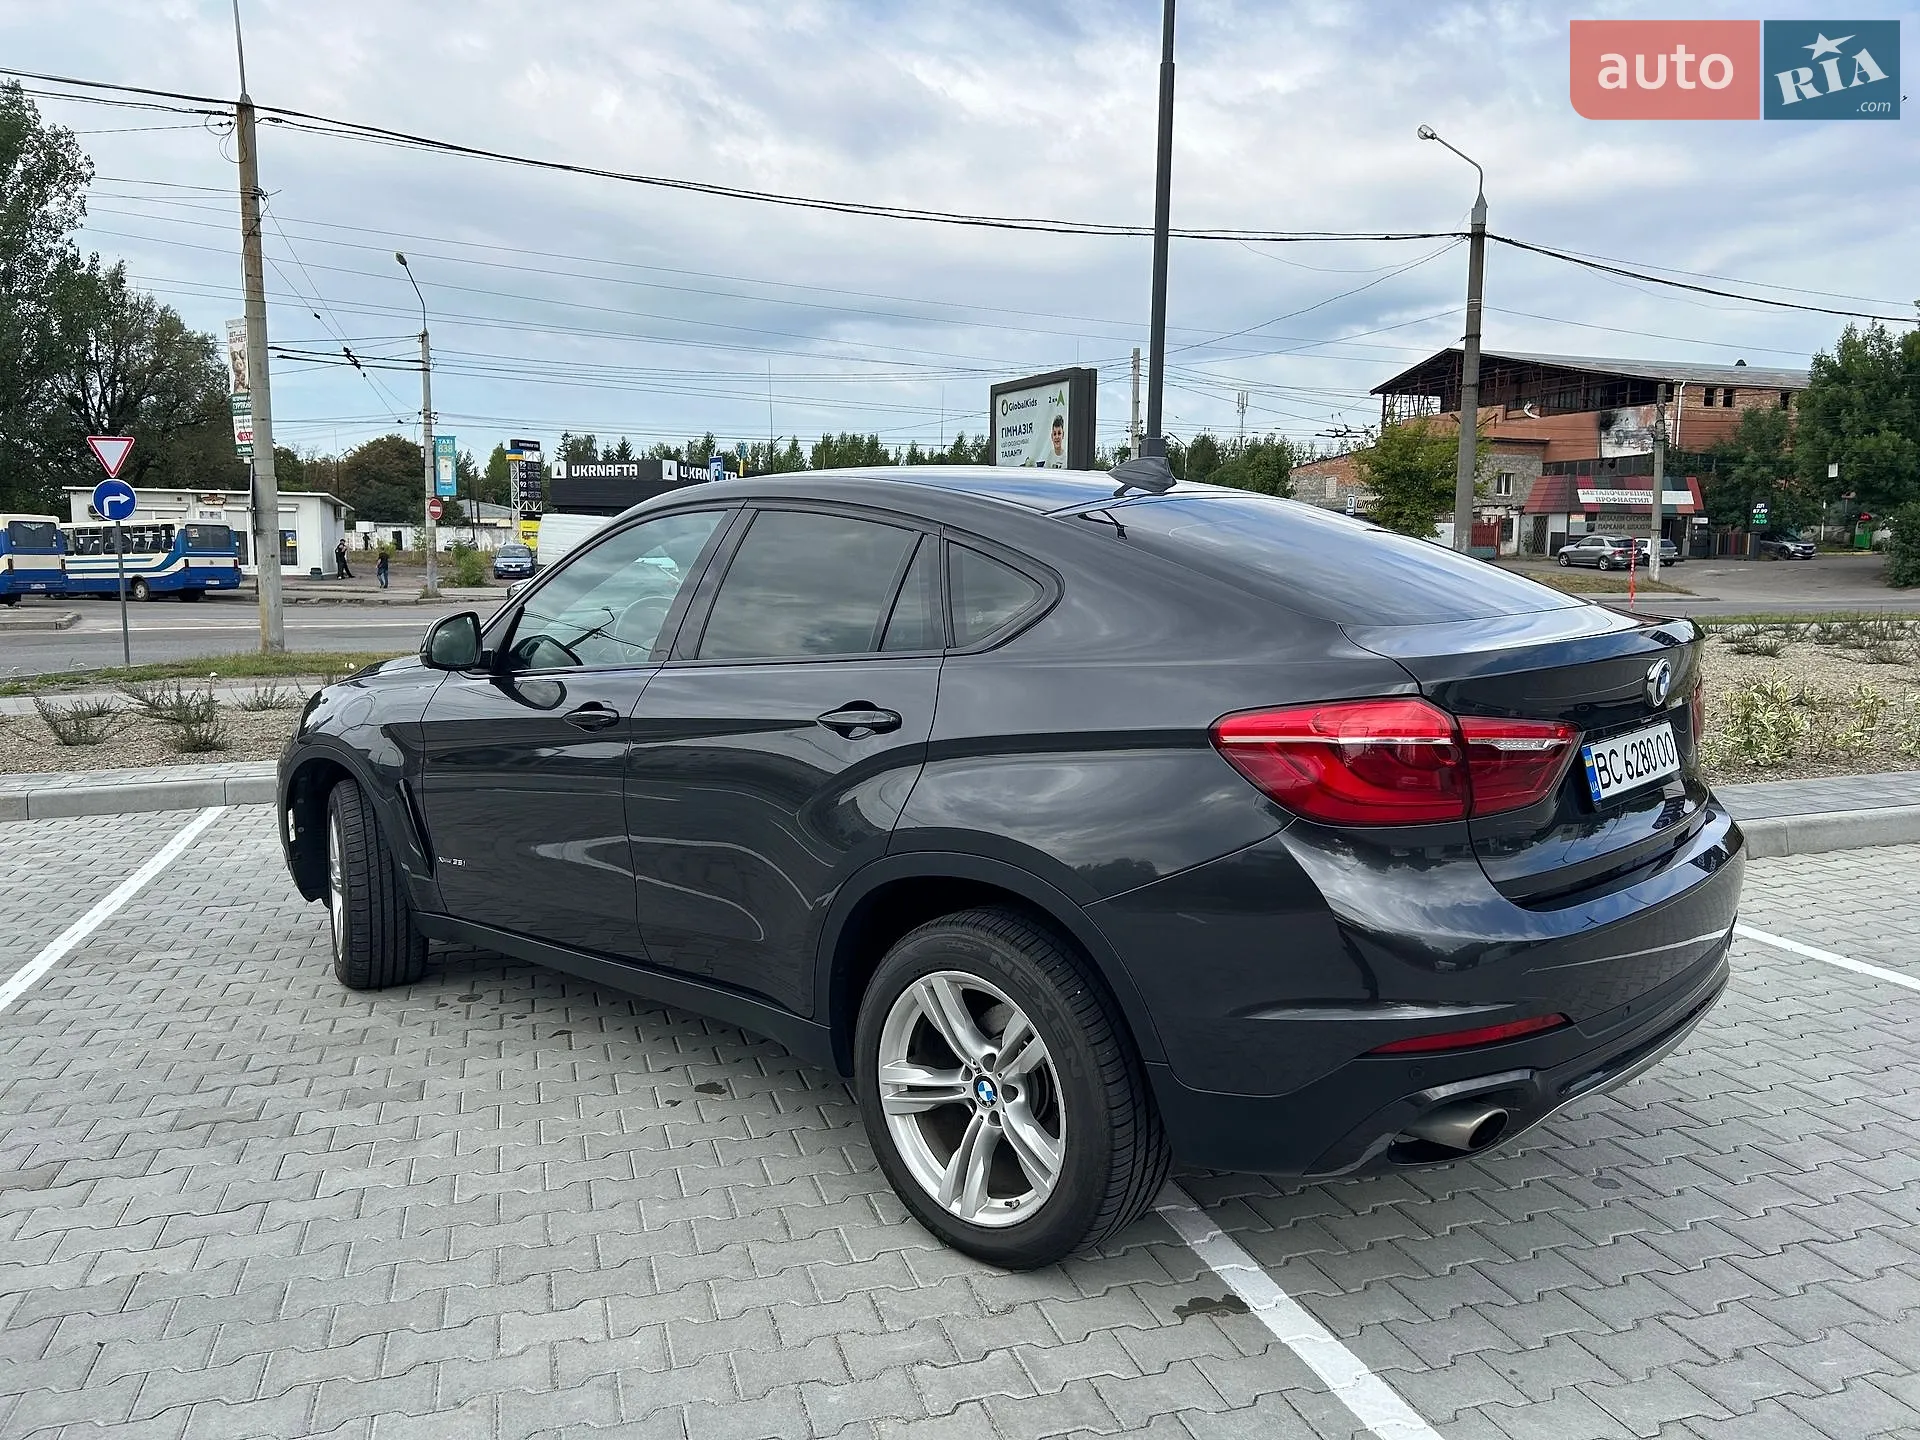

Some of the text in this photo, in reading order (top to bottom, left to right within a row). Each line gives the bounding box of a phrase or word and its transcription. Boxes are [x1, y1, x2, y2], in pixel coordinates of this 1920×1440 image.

[1009, 398, 1038, 411] GlobalKids
[1001, 422, 1033, 439] ГІМНАЗІЯ
[520, 471, 527, 479] 95
[571, 463, 638, 478] UKRNAFTA
[680, 465, 738, 482] UKRNTA
[520, 480, 527, 488] 92
[1582, 490, 1653, 498] МЕТАЛОЧЕРЕПИЦ
[1595, 496, 1650, 504] ПРОФНАСТИЛ
[1594, 748, 1623, 789] BC
[1624, 736, 1658, 780] 6280
[1589, 780, 1600, 794] UA
[989, 951, 1084, 1080] NEXEN
